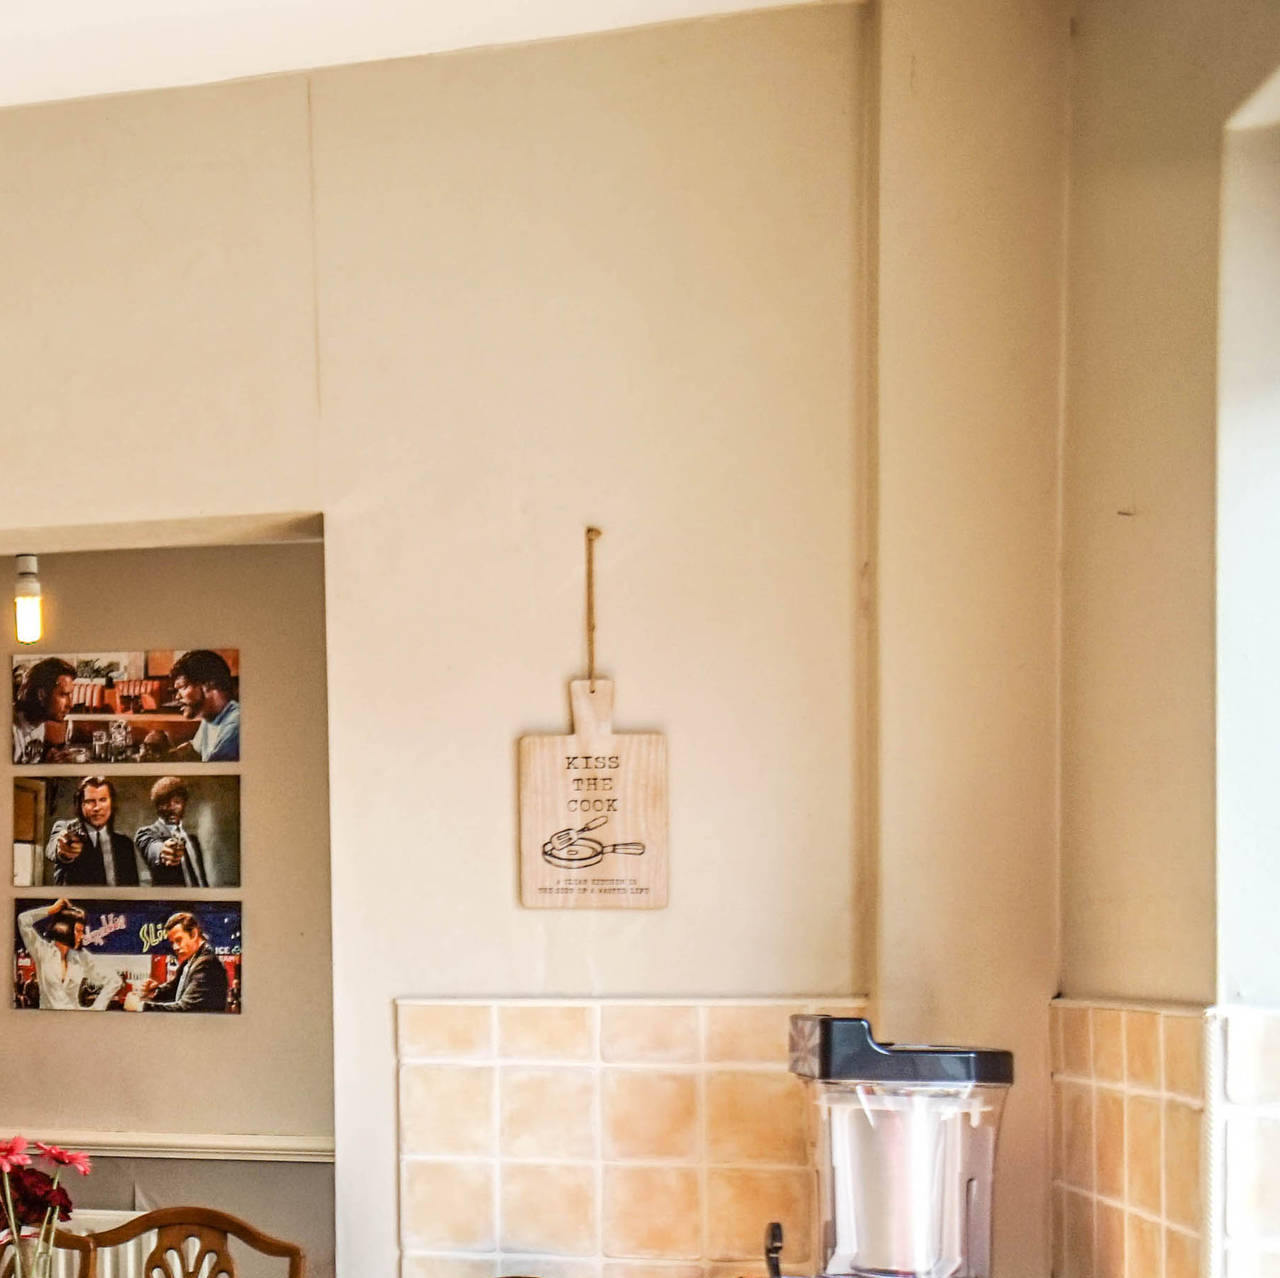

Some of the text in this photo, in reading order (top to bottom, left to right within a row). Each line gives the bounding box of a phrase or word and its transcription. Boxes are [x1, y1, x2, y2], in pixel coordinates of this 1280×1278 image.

[565, 756, 620, 770] KISS
[572, 777, 613, 791] THE
[566, 798, 619, 812] COOK
